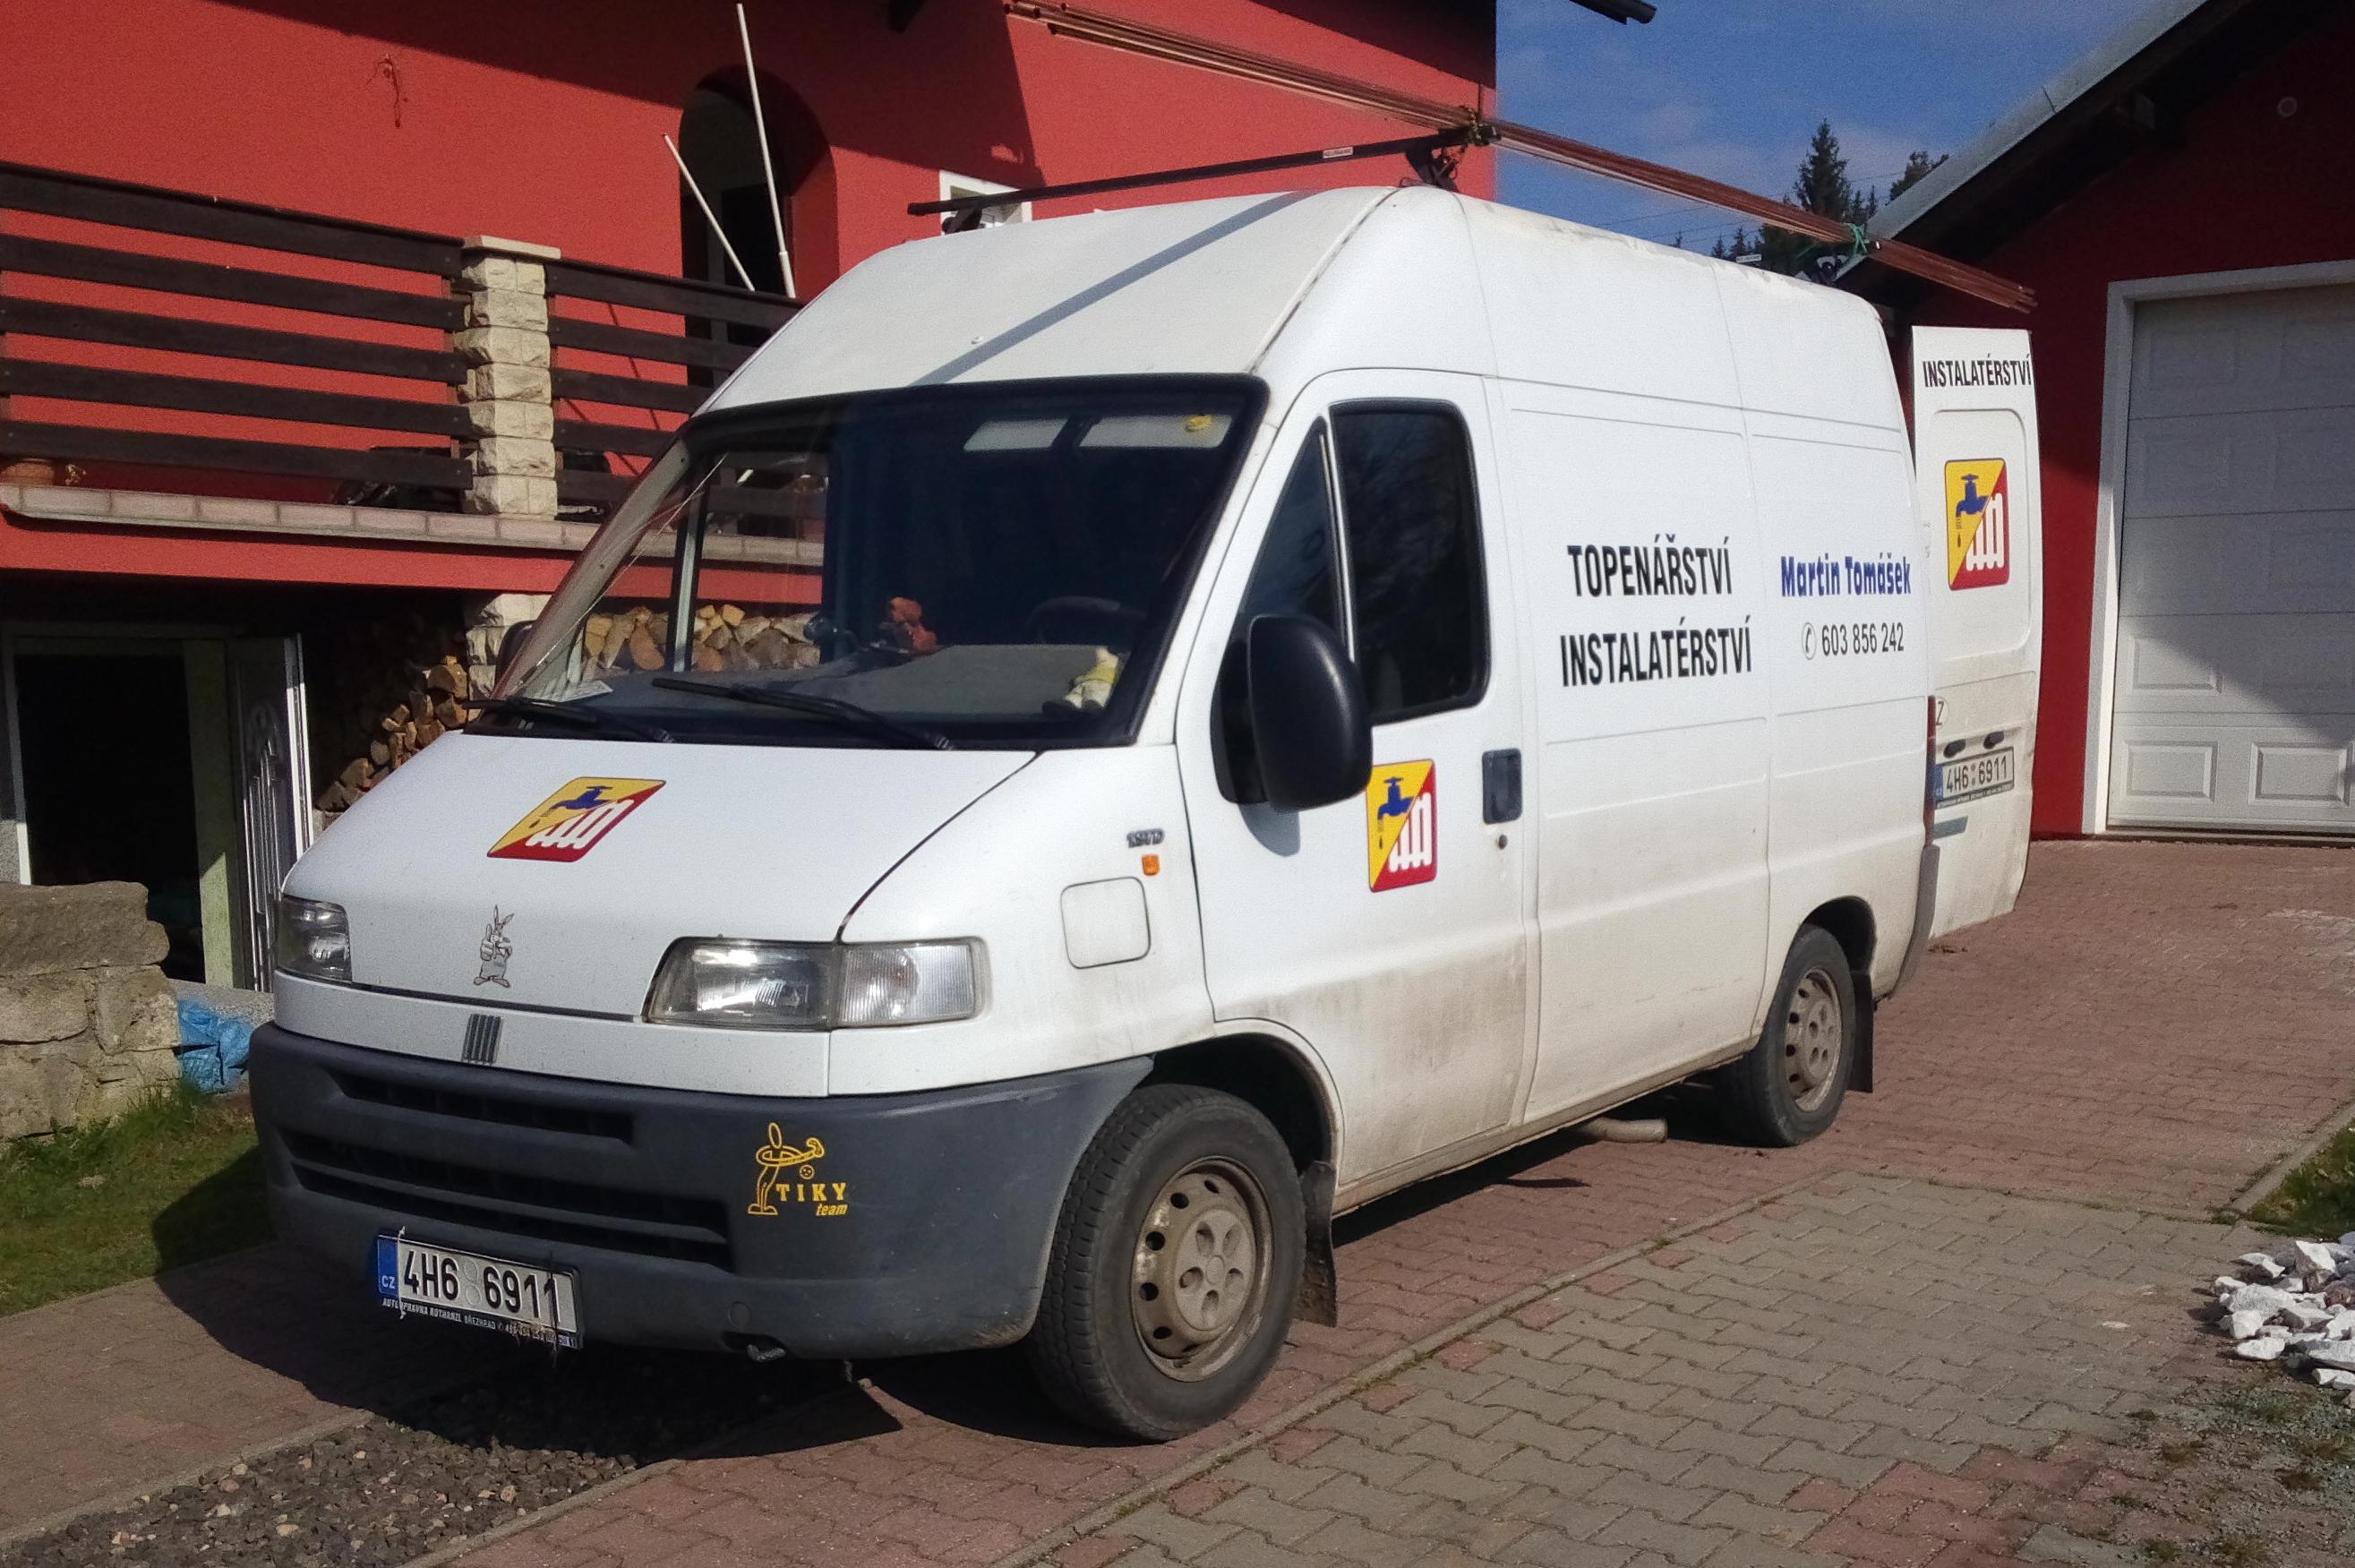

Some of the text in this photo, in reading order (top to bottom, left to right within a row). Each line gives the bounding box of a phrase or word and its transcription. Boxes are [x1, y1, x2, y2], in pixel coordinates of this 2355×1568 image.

[1922, 353, 2032, 388] INSTALATÉRSTVÍ
[1567, 533, 1733, 597] TOPENÁŘSTVÍ
[1780, 553, 1912, 597] Martin Tomášek
[1560, 614, 1752, 688] INSTALATÉRSTVÍ
[1821, 621, 1905, 657] 603 856 242
[1946, 765, 1969, 793] 4H6
[1978, 755, 2008, 785] 6911
[775, 1182, 847, 1202] TIKY
[816, 1204, 849, 1216] team
[381, 1274, 396, 1290] CZ
[404, 1250, 561, 1324] 4H6 6911
